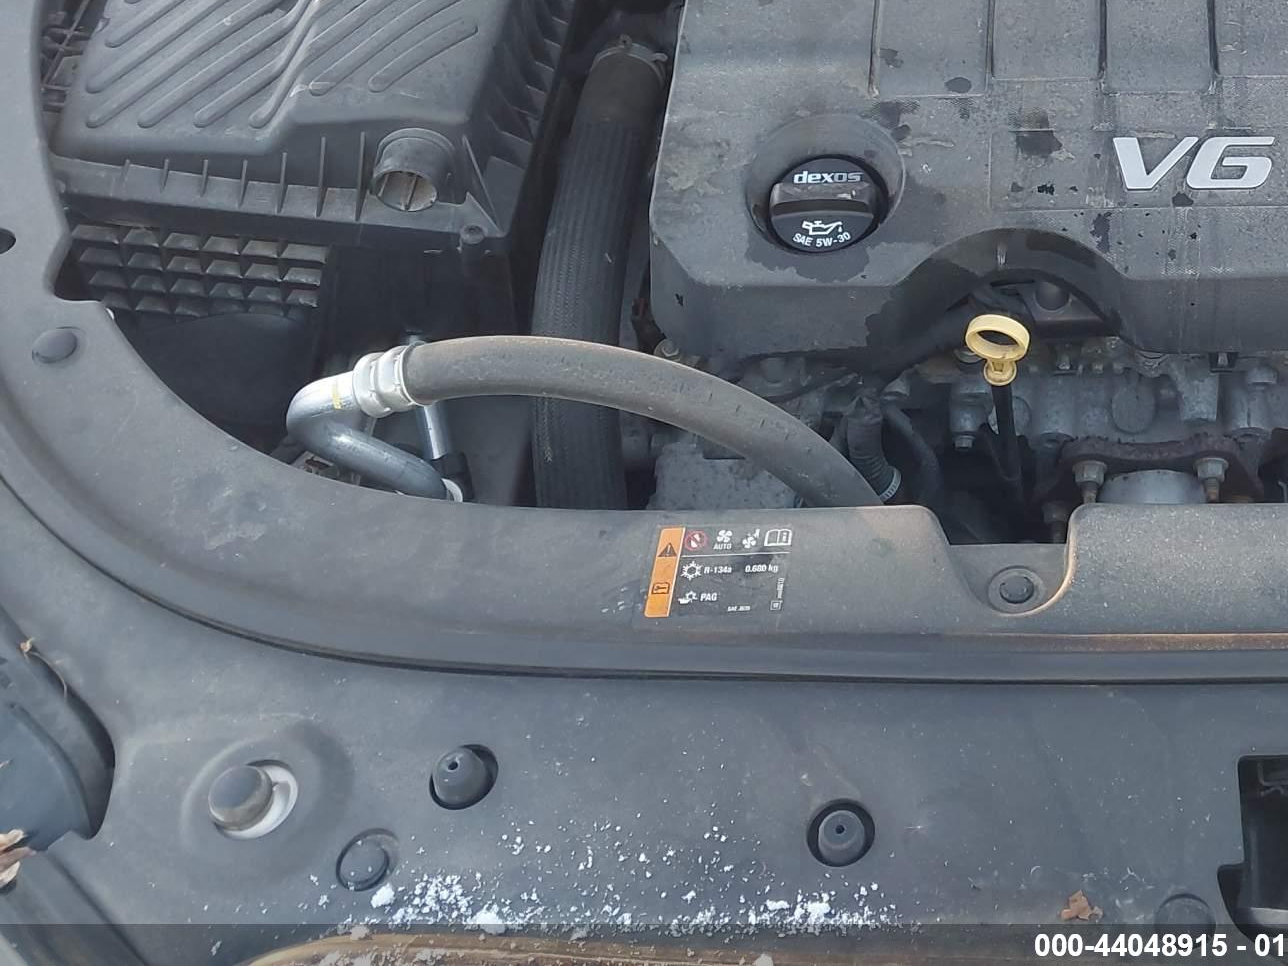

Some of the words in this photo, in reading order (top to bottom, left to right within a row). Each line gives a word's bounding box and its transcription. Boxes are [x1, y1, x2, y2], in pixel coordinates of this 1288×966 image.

[1112, 135, 1275, 190] V6
[793, 170, 864, 184] dexos
[792, 232, 813, 246] SAE
[815, 231, 851, 247] 5W-30
[713, 542, 732, 550] AUTO
[704, 566, 732, 574] R-134a
[768, 564, 779, 573] kg
[700, 592, 718, 602] PAG
